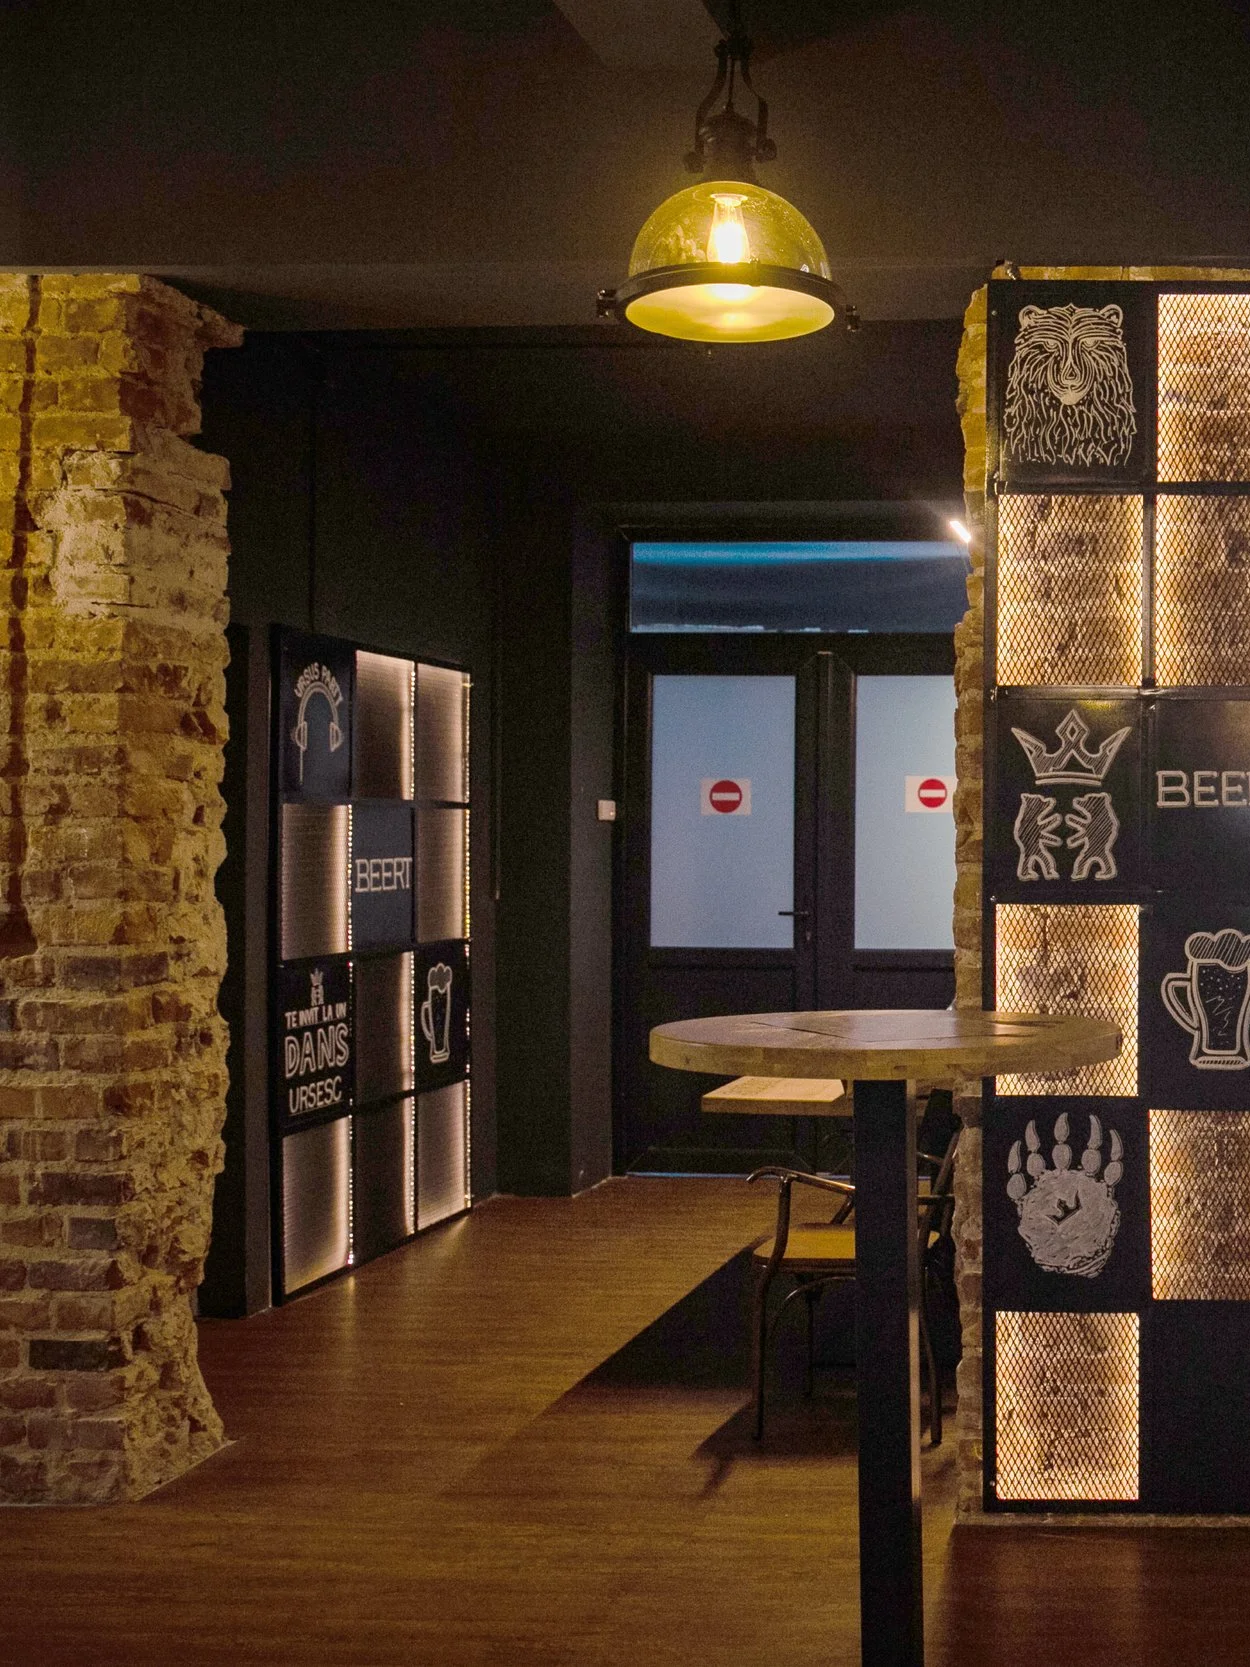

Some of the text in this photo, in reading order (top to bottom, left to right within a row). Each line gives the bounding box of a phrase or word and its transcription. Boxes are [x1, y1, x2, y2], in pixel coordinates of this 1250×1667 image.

[294, 662, 320, 698] URSUS
[355, 857, 413, 892] BEERT
[284, 1010, 297, 1030] TE
[322, 1004, 334, 1022] LA
[335, 1002, 347, 1020] UN
[284, 1022, 350, 1078] DANS
[289, 1076, 342, 1114] URSESC
